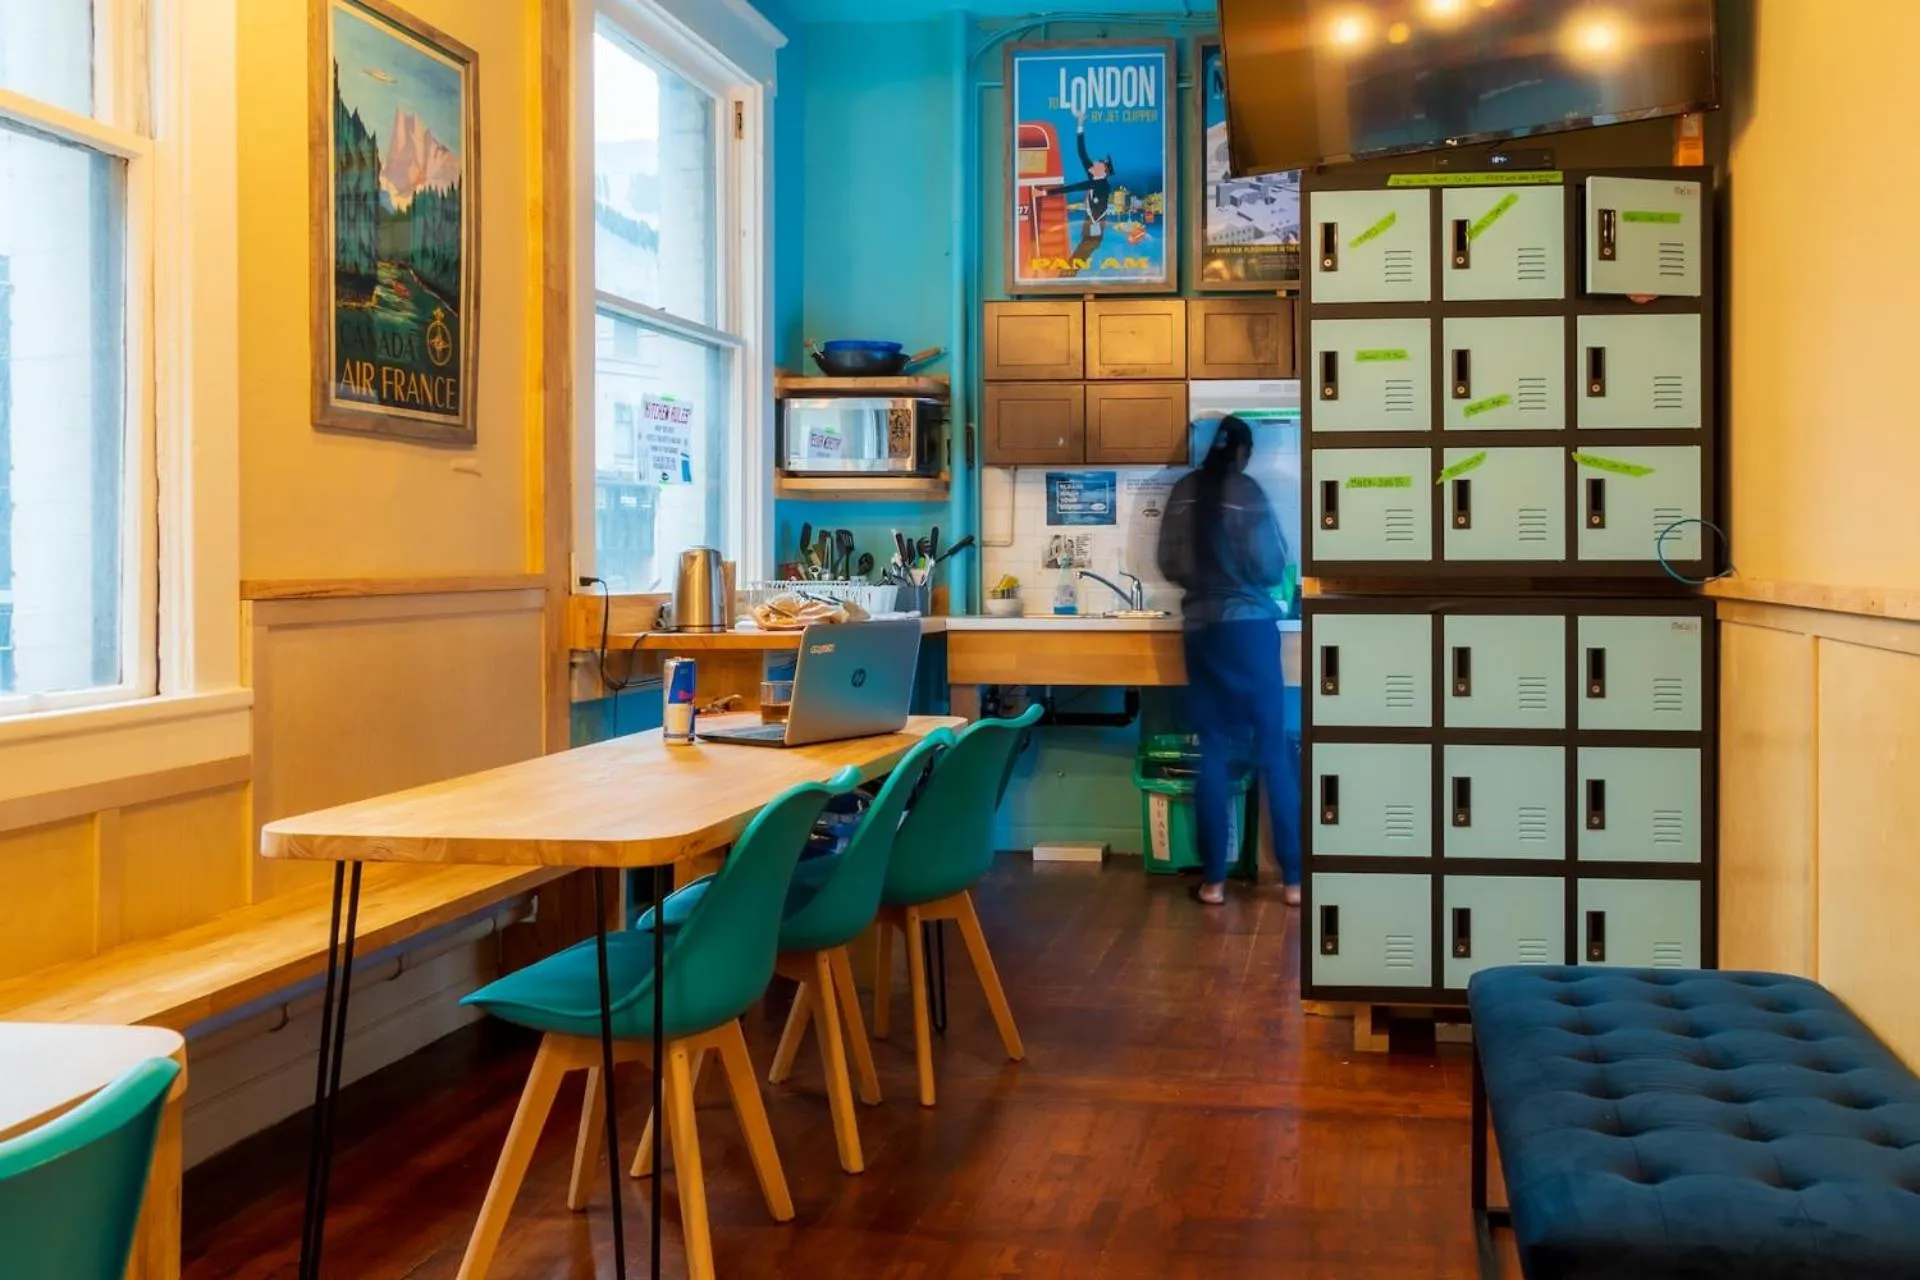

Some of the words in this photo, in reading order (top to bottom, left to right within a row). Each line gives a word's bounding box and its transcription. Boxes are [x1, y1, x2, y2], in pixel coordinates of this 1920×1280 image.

[1060, 66, 1155, 117] LONDON
[1031, 257, 1091, 270] PAN
[1101, 256, 1149, 270] AM
[340, 358, 375, 397] AIR
[381, 366, 457, 410] FRANCE
[644, 401, 669, 420] KITCHEN
